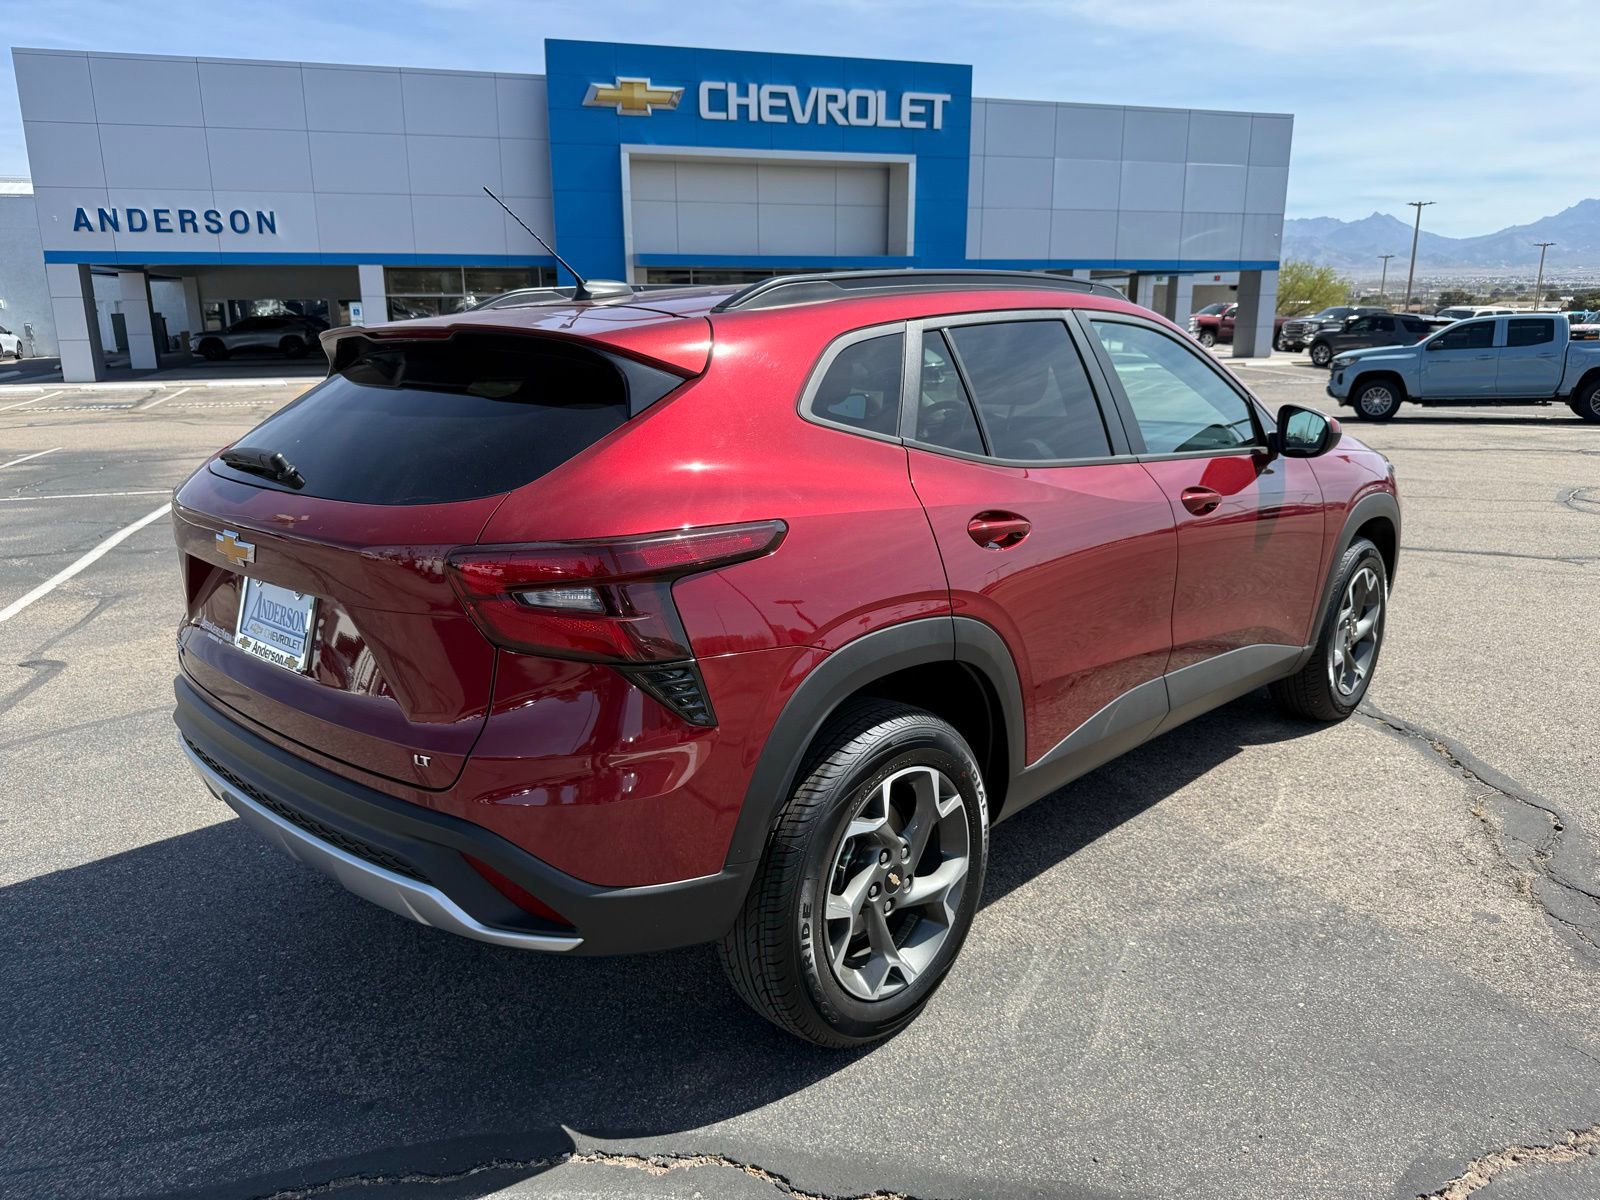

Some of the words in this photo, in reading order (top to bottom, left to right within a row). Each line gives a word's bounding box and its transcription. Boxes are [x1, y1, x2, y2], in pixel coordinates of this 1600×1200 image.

[699, 81, 951, 130] CHEVROLET
[73, 207, 277, 235] ANDERSON
[243, 590, 308, 634] ANDERSON
[413, 754, 431, 768] LT
